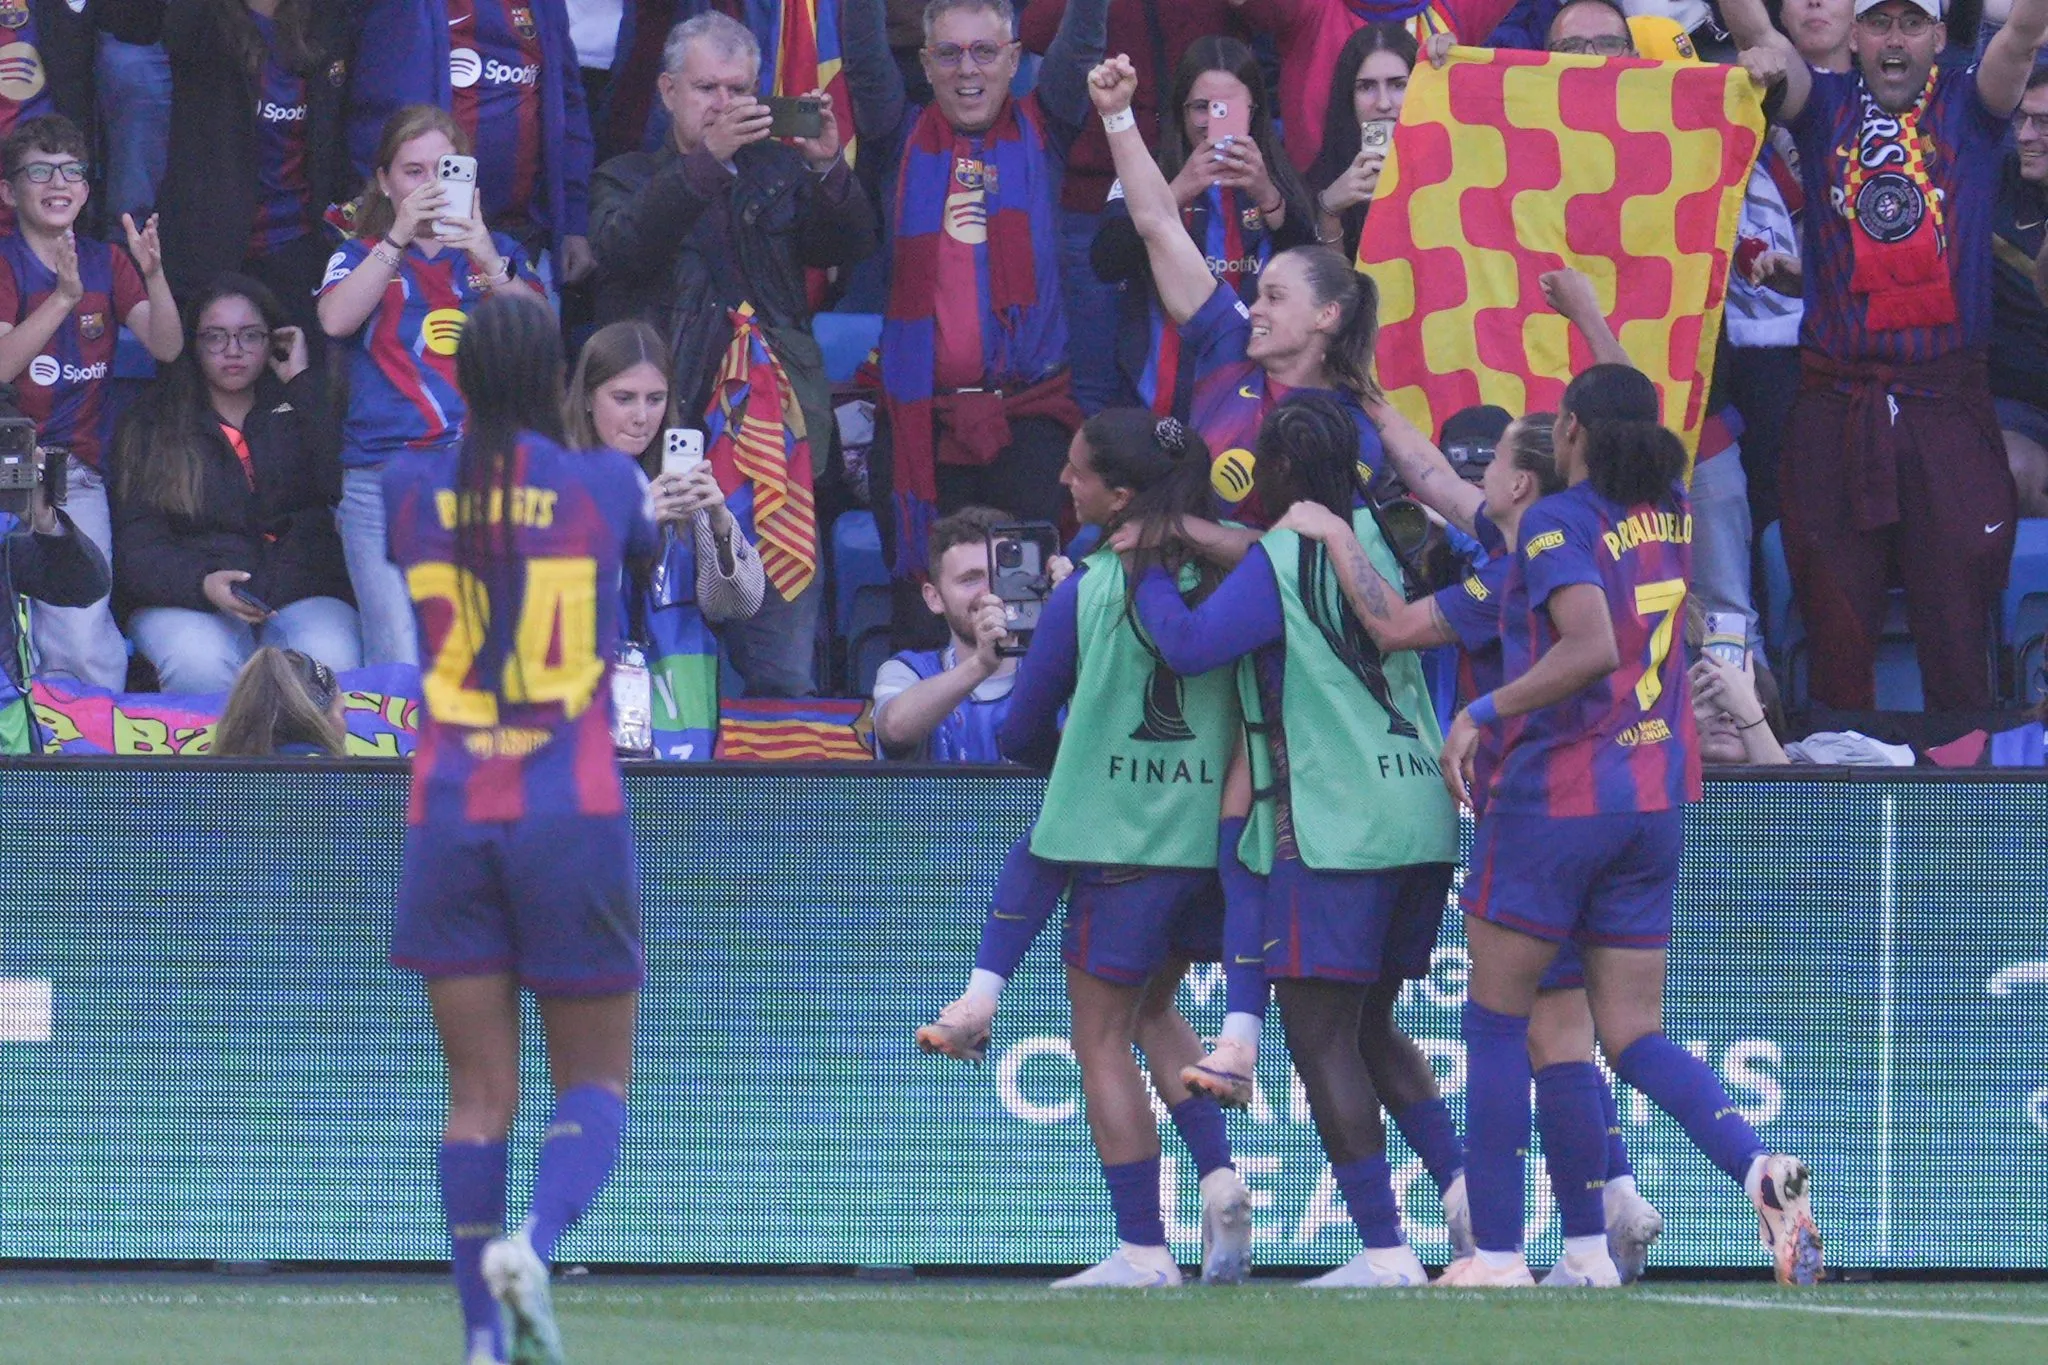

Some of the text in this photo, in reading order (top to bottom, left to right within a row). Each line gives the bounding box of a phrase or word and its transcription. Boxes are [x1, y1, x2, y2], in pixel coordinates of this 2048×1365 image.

[263, 102, 307, 122] Spoti
[1205, 255, 1264, 275] Spotify
[63, 362, 108, 384] Spotif
[406, 556, 605, 727] 24
[1634, 577, 1687, 711] 7
[1109, 755, 1214, 785] FINAL
